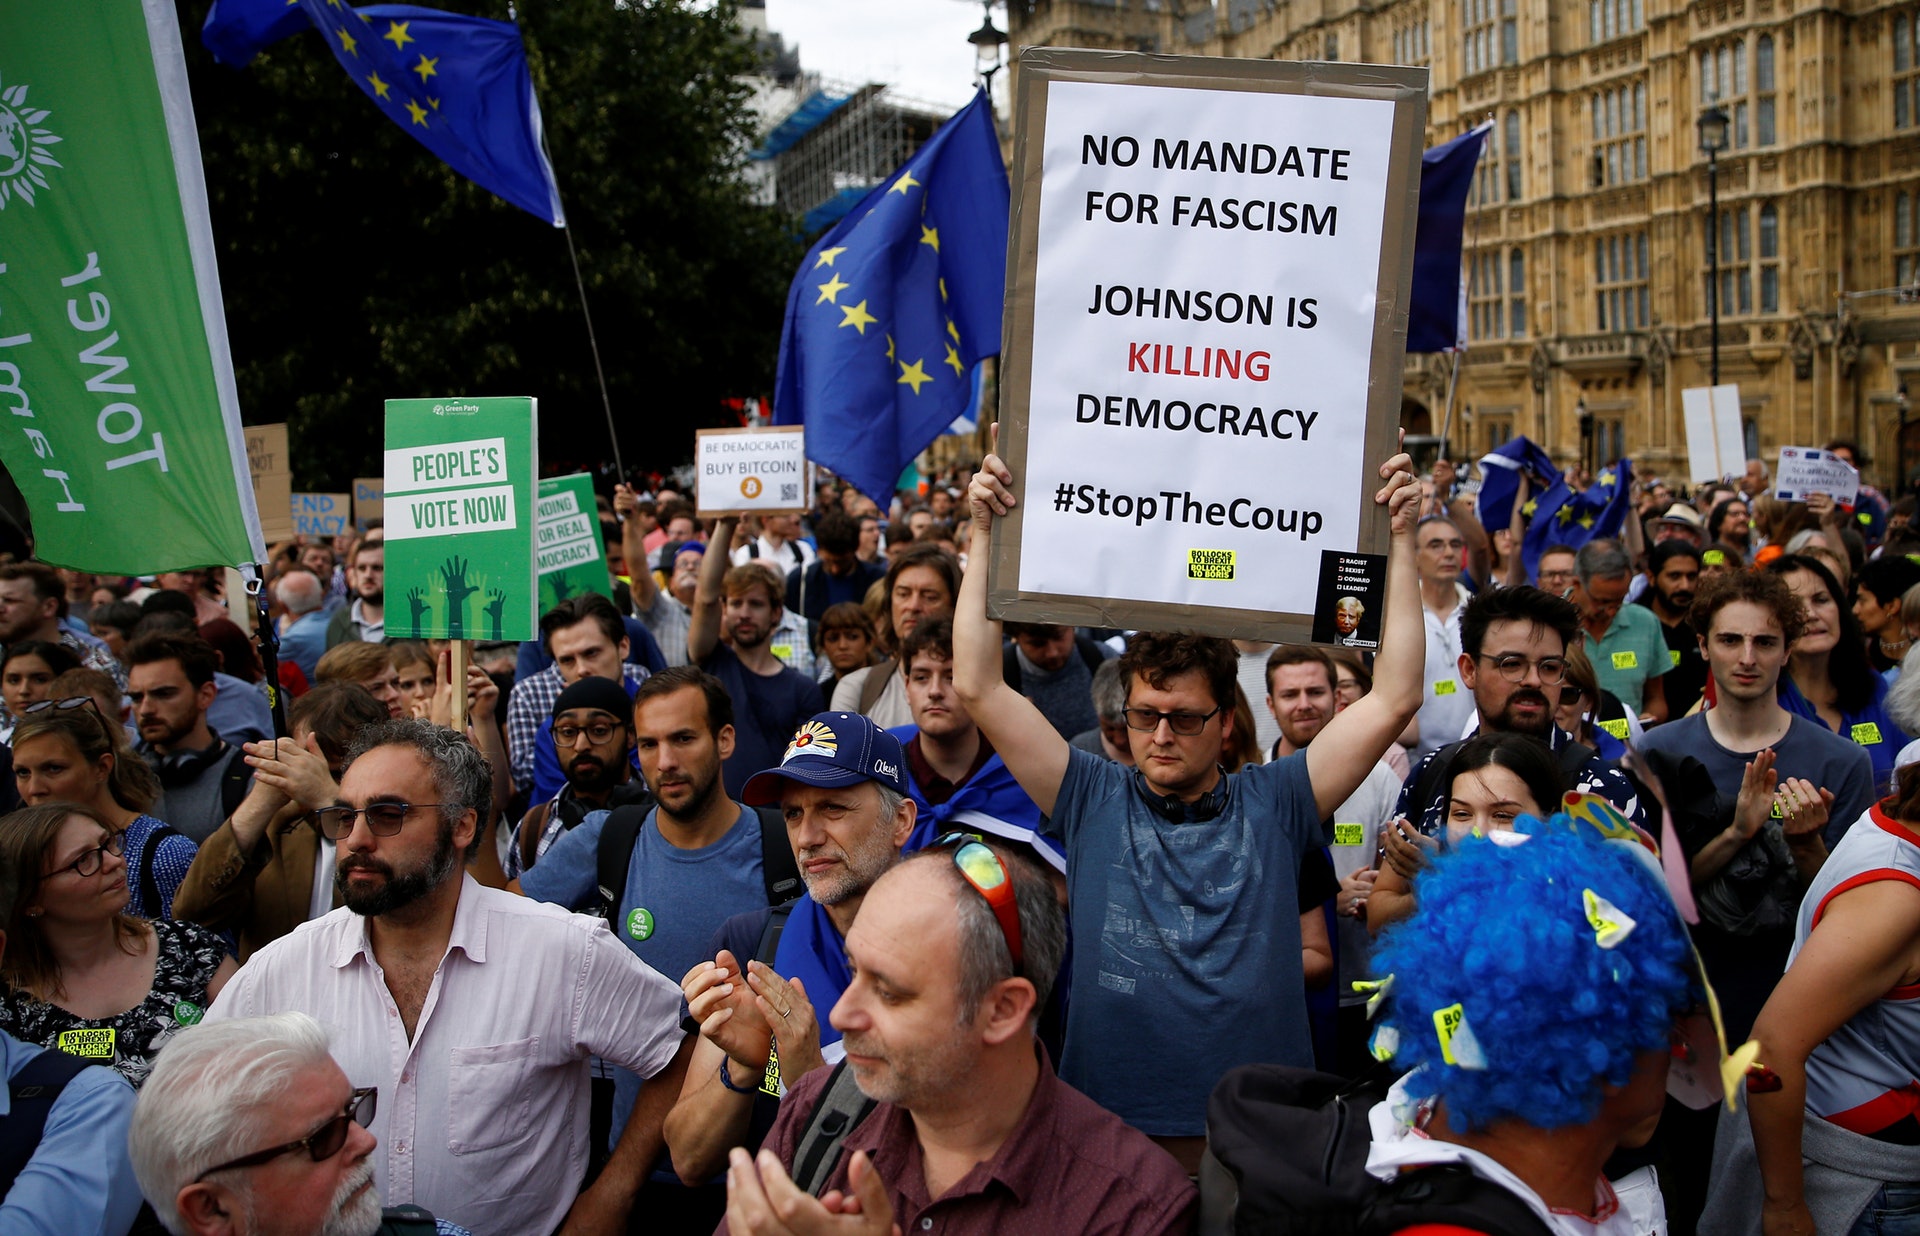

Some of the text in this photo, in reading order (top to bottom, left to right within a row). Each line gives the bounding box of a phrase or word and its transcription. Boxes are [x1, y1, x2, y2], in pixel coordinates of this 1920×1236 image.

[1082, 135, 1351, 180] NO MANDATE
[1085, 190, 1338, 236] FOR FASCISM
[1088, 284, 1318, 330] JOHNSON IS
[1128, 342, 1271, 382] KILLING
[463, 405, 479, 413] Party
[1076, 393, 1319, 441] DEMOCRACY
[706, 440, 798, 453] BE DEMOCRATIC
[412, 447, 499, 482] PEOPLE'S
[706, 461, 797, 475] BUY BITCOIN
[411, 495, 507, 529] VOTE NOW
[1053, 482, 1323, 542] #StopTheCoup
[292, 515, 346, 536] RACY
[556, 519, 587, 539] REAL
[1191, 550, 1233, 559] BOLLOCKS
[1204, 557, 1232, 565] BREXIT
[1190, 564, 1232, 573] BOLLOCKS
[1346, 558, 1367, 566] RACIST
[1193, 570, 1230, 579] TO BORIS
[1345, 567, 1365, 575] SEXIST
[1344, 576, 1371, 584] COWARD
[1343, 584, 1368, 593] LEADER?
[64, 1030, 111, 1040] BOLLOCKS
[79, 1036, 109, 1044] BREXIT
